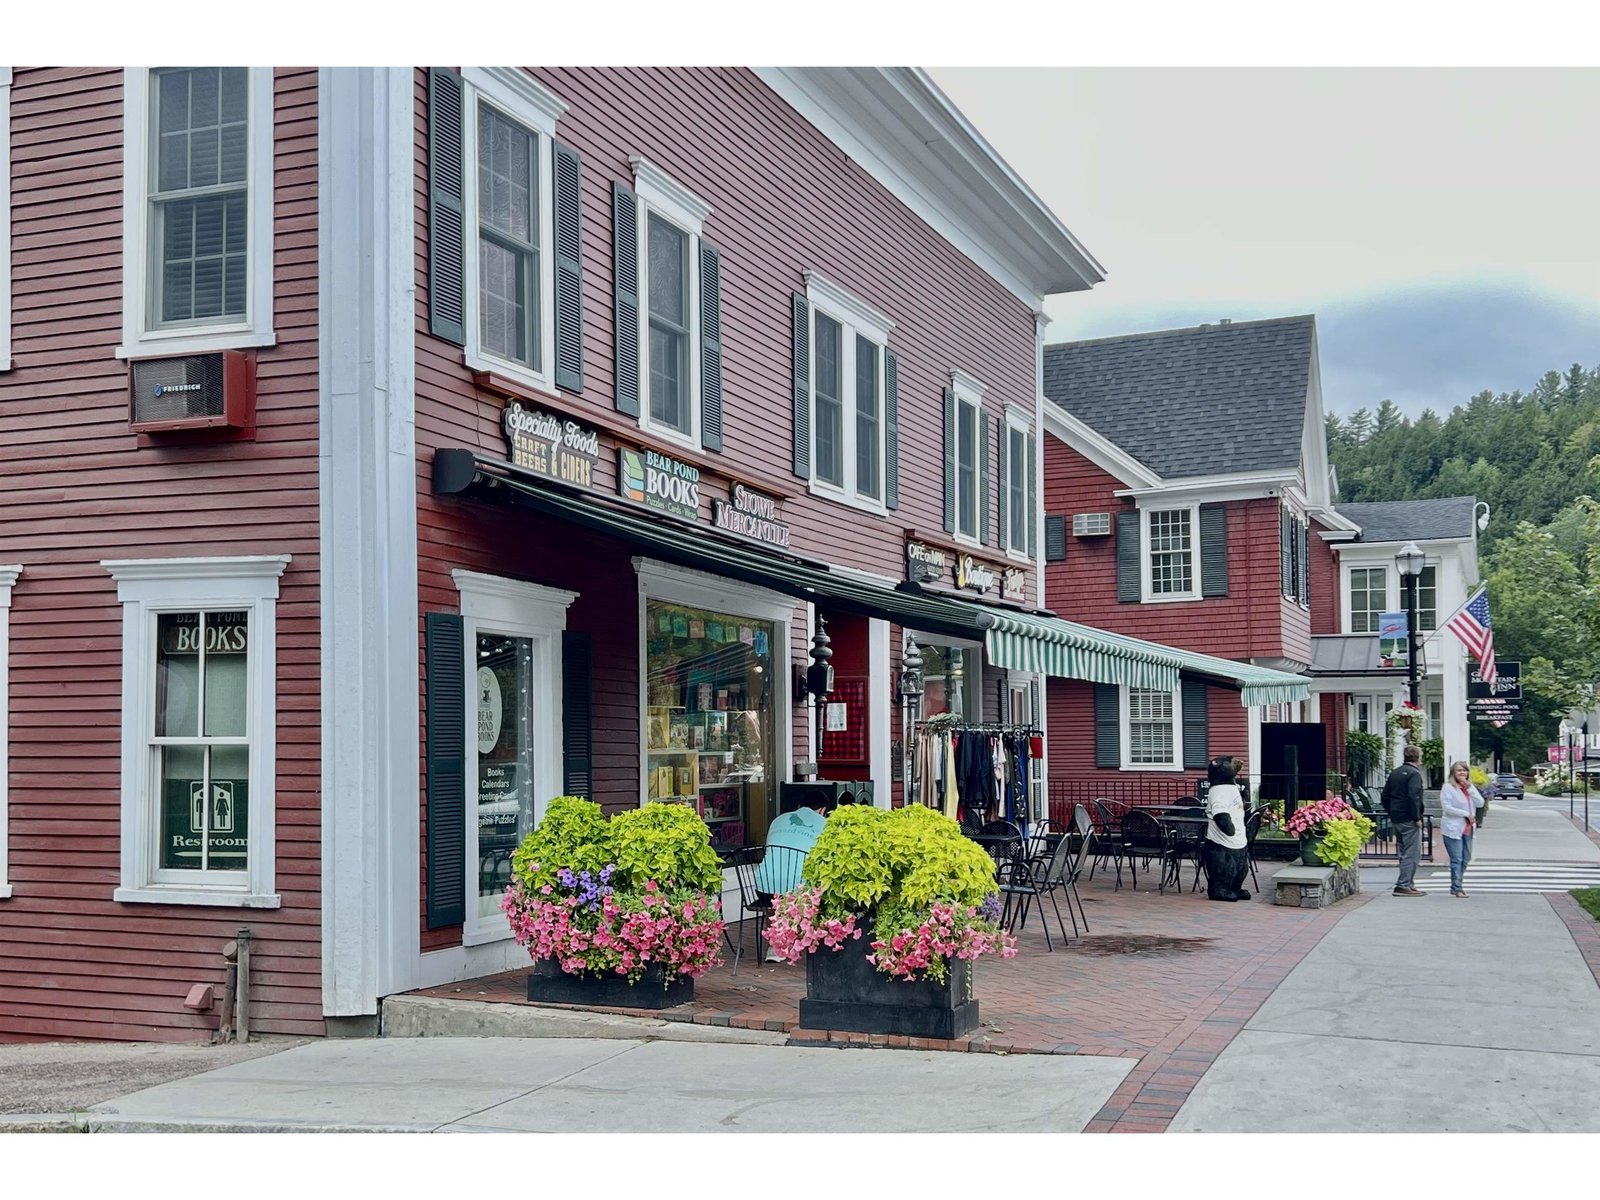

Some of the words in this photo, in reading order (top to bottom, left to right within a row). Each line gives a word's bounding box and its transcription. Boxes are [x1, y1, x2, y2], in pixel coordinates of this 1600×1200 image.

[163, 383, 201, 393] FRIEDRICH
[508, 402, 563, 454] Specialty
[563, 420, 600, 457] Foods
[514, 433, 548, 456] CRAFT
[514, 449, 547, 473] BEERS
[560, 451, 592, 487] CIDERS
[646, 450, 672, 473] BEAR
[673, 460, 700, 482] POND
[645, 467, 700, 509] BOOKS
[646, 495, 665, 510] Puzzles
[667, 502, 682, 515] Cards
[176, 614, 212, 623] BEA
[176, 625, 248, 651] BOOKS
[1497, 683, 1517, 691] INN
[487, 767, 505, 777] Books
[481, 780, 510, 789] Calendars
[478, 791, 500, 802] reeting
[172, 835, 248, 847] Resroom
